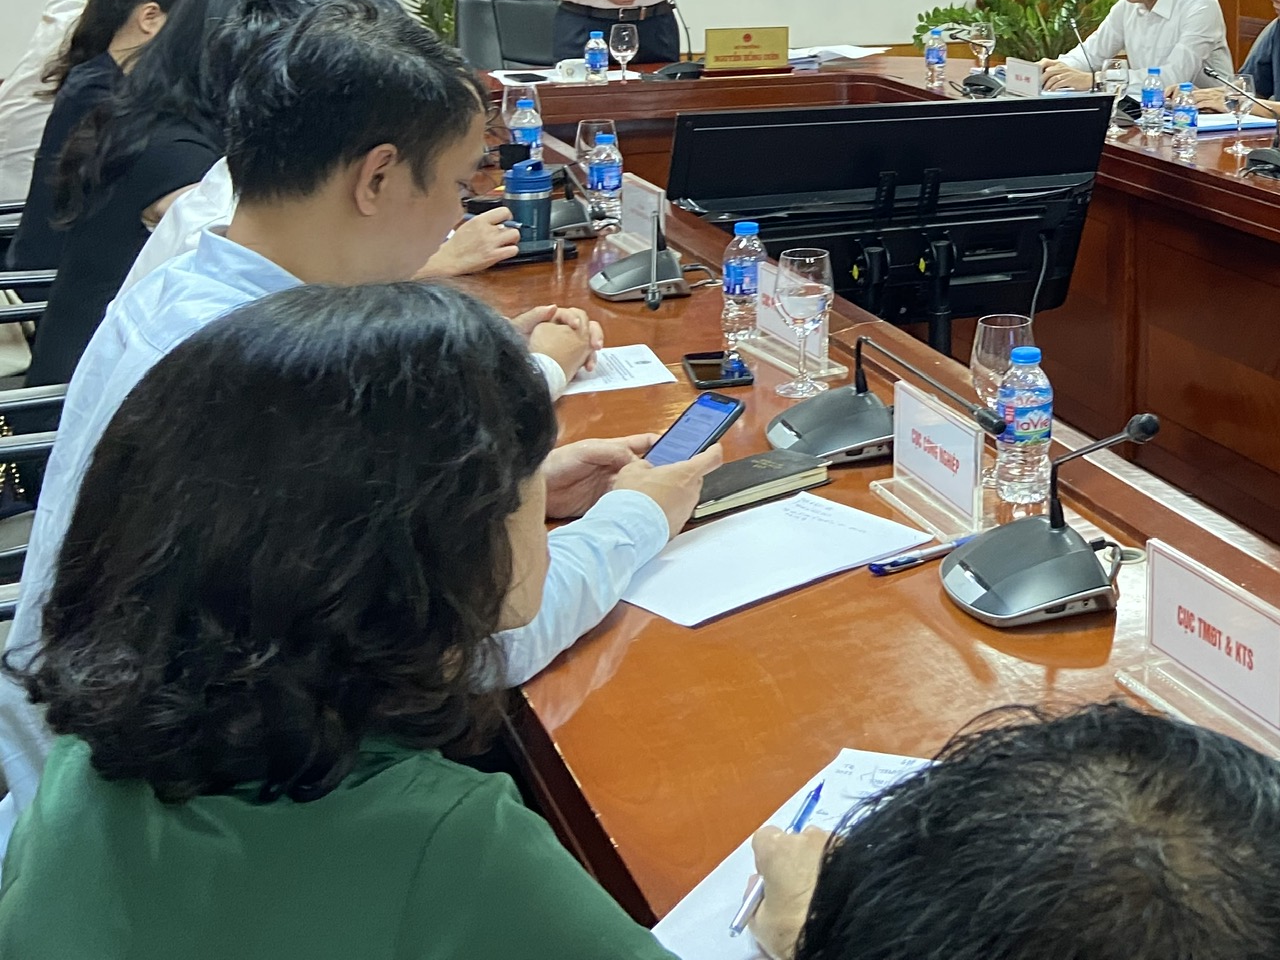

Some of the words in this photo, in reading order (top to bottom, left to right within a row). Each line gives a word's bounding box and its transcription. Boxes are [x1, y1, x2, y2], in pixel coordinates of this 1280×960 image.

[911, 428, 922, 449] CỤC
[1177, 605, 1195, 634] CỤC
[1225, 635, 1233, 657] &
[1235, 640, 1254, 671] KTS
